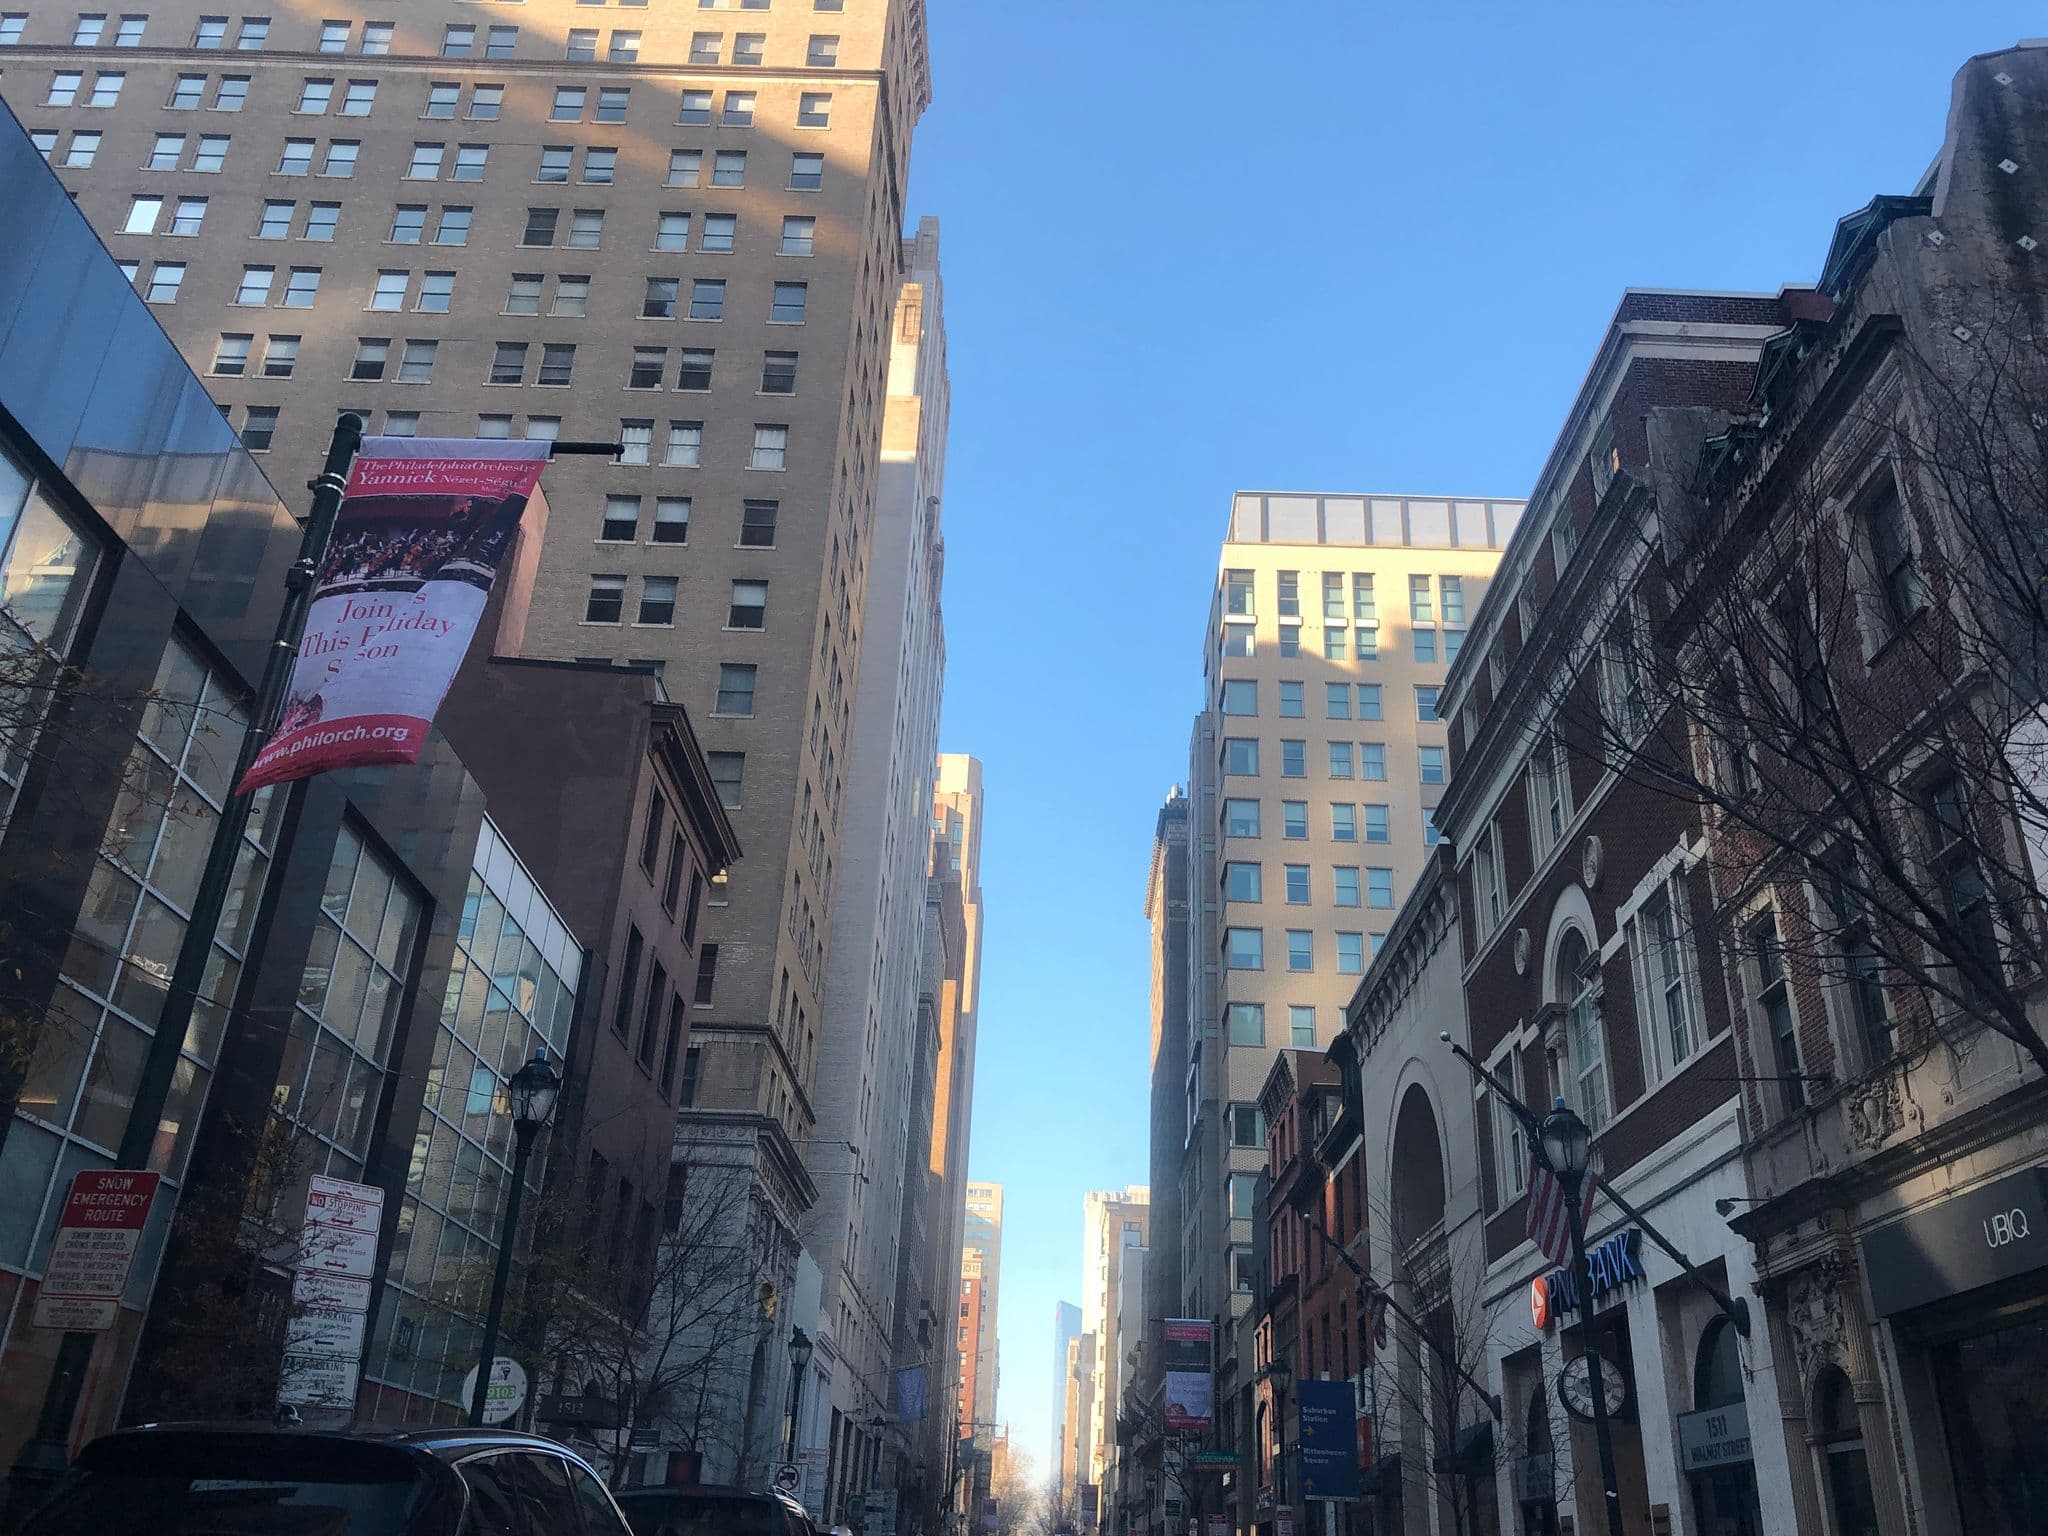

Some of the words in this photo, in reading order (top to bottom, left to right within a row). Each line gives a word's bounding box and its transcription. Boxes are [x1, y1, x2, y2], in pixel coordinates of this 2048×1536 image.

[359, 470, 436, 485] Yannick
[337, 598, 394, 624] Join
[303, 630, 350, 657] This
[252, 724, 409, 769] www.philorch.org
[97, 1177, 134, 1190] SNOW
[72, 1192, 149, 1206] EMERGENCY
[311, 1195, 325, 1206] NO
[329, 1198, 367, 1213] STOPPING
[84, 1208, 126, 1222] ROUTE
[1983, 1208, 2030, 1248] UBIQ
[1706, 1414, 1728, 1438] 1511
[1721, 1439, 1750, 1458] STREET
